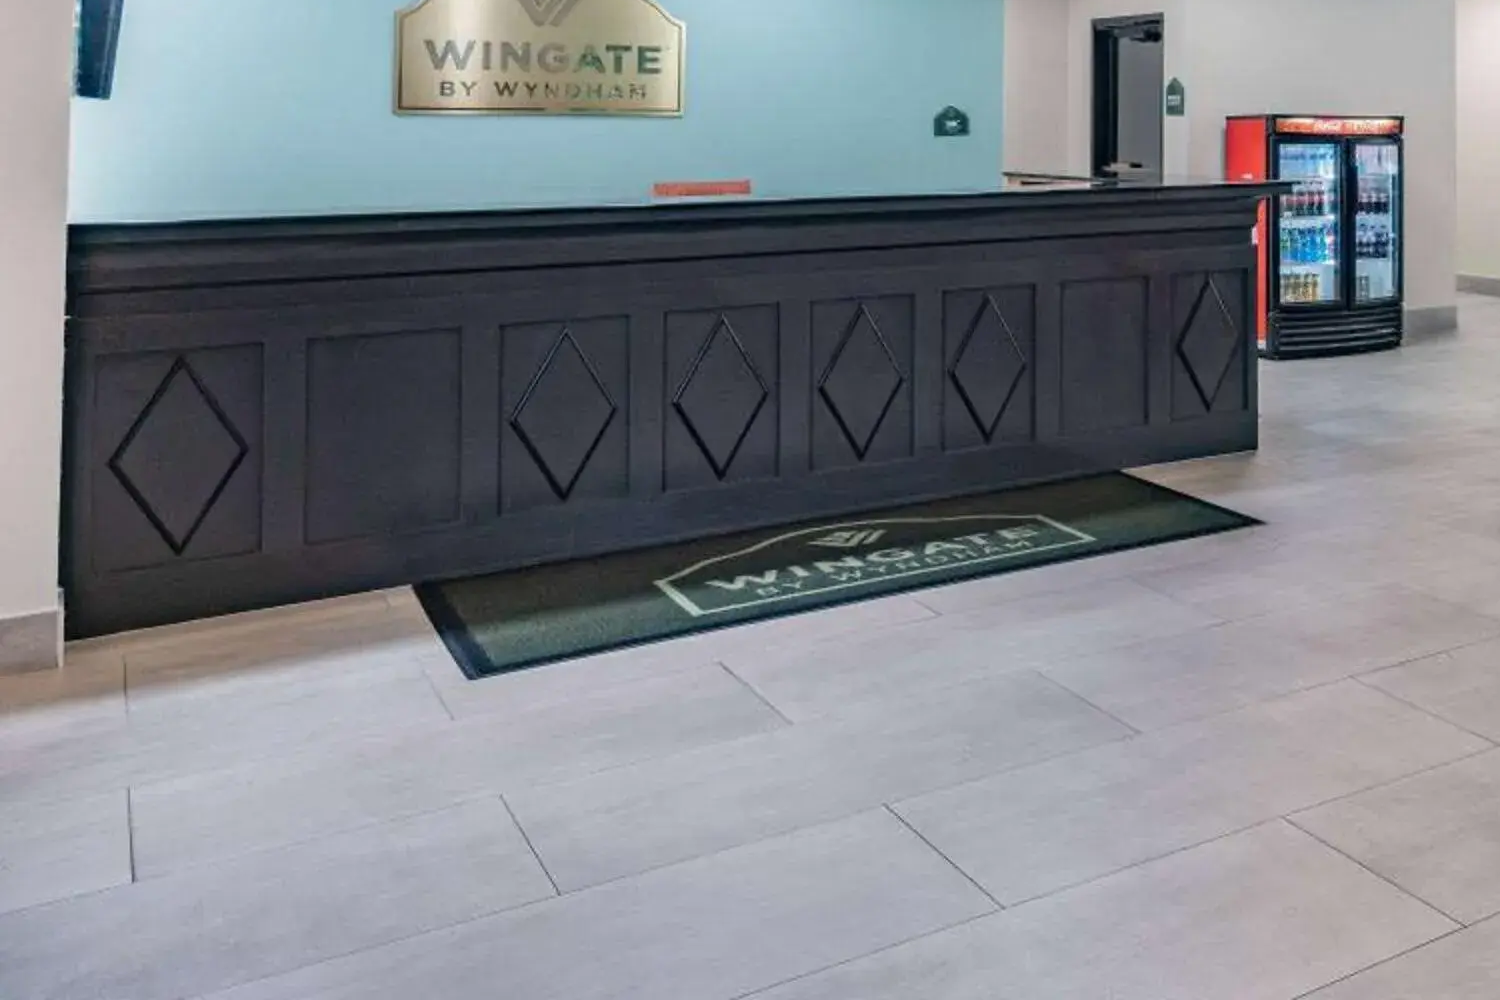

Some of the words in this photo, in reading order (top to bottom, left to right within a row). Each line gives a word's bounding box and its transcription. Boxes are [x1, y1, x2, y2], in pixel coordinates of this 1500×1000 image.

[423, 39, 662, 75] WINGATE
[440, 81, 478, 98] BY
[493, 81, 646, 100] WYNDHAM
[704, 524, 1039, 590] WINGATE
